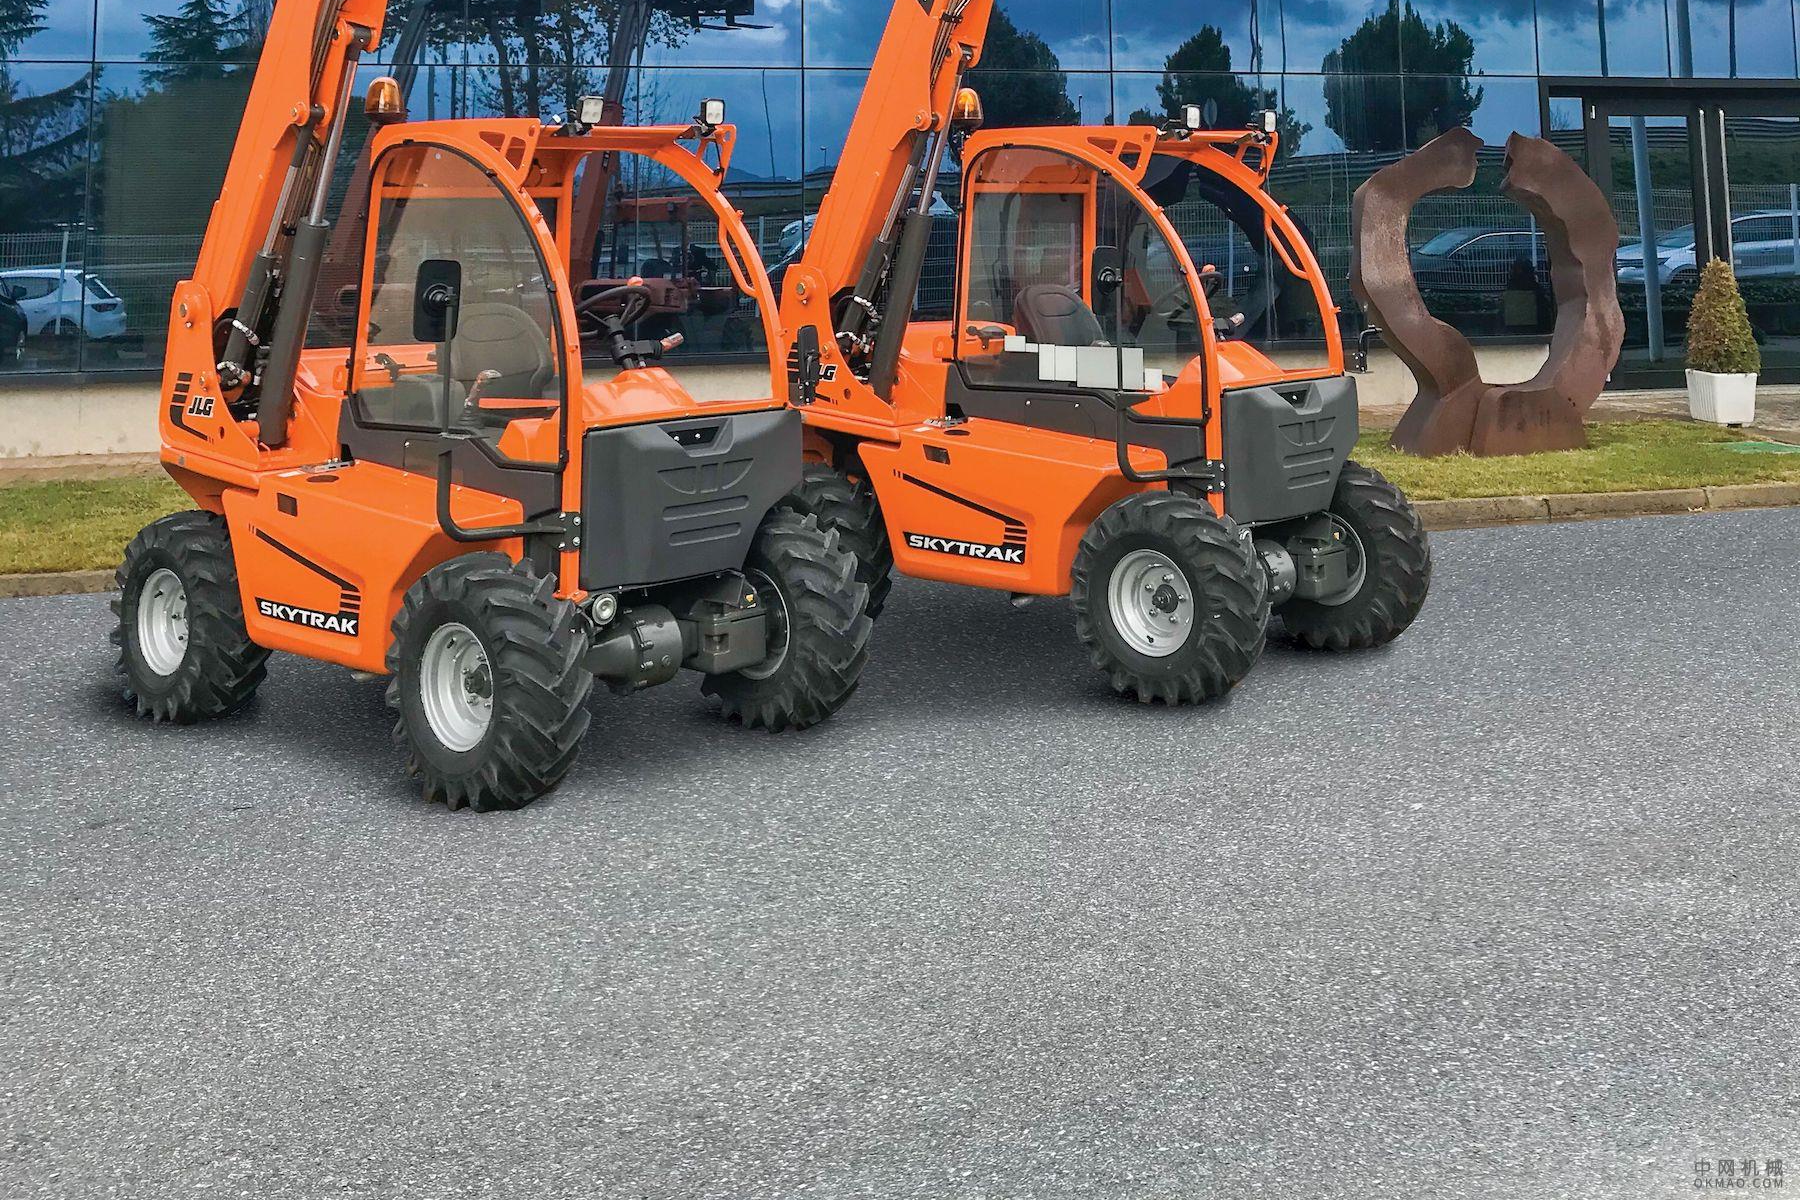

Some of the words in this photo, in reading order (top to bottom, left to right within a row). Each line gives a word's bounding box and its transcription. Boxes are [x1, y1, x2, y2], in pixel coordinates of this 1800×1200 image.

[187, 395, 215, 418] JLG
[909, 534, 1024, 563] SKYTRAK
[260, 600, 357, 635] SKYTRAK
